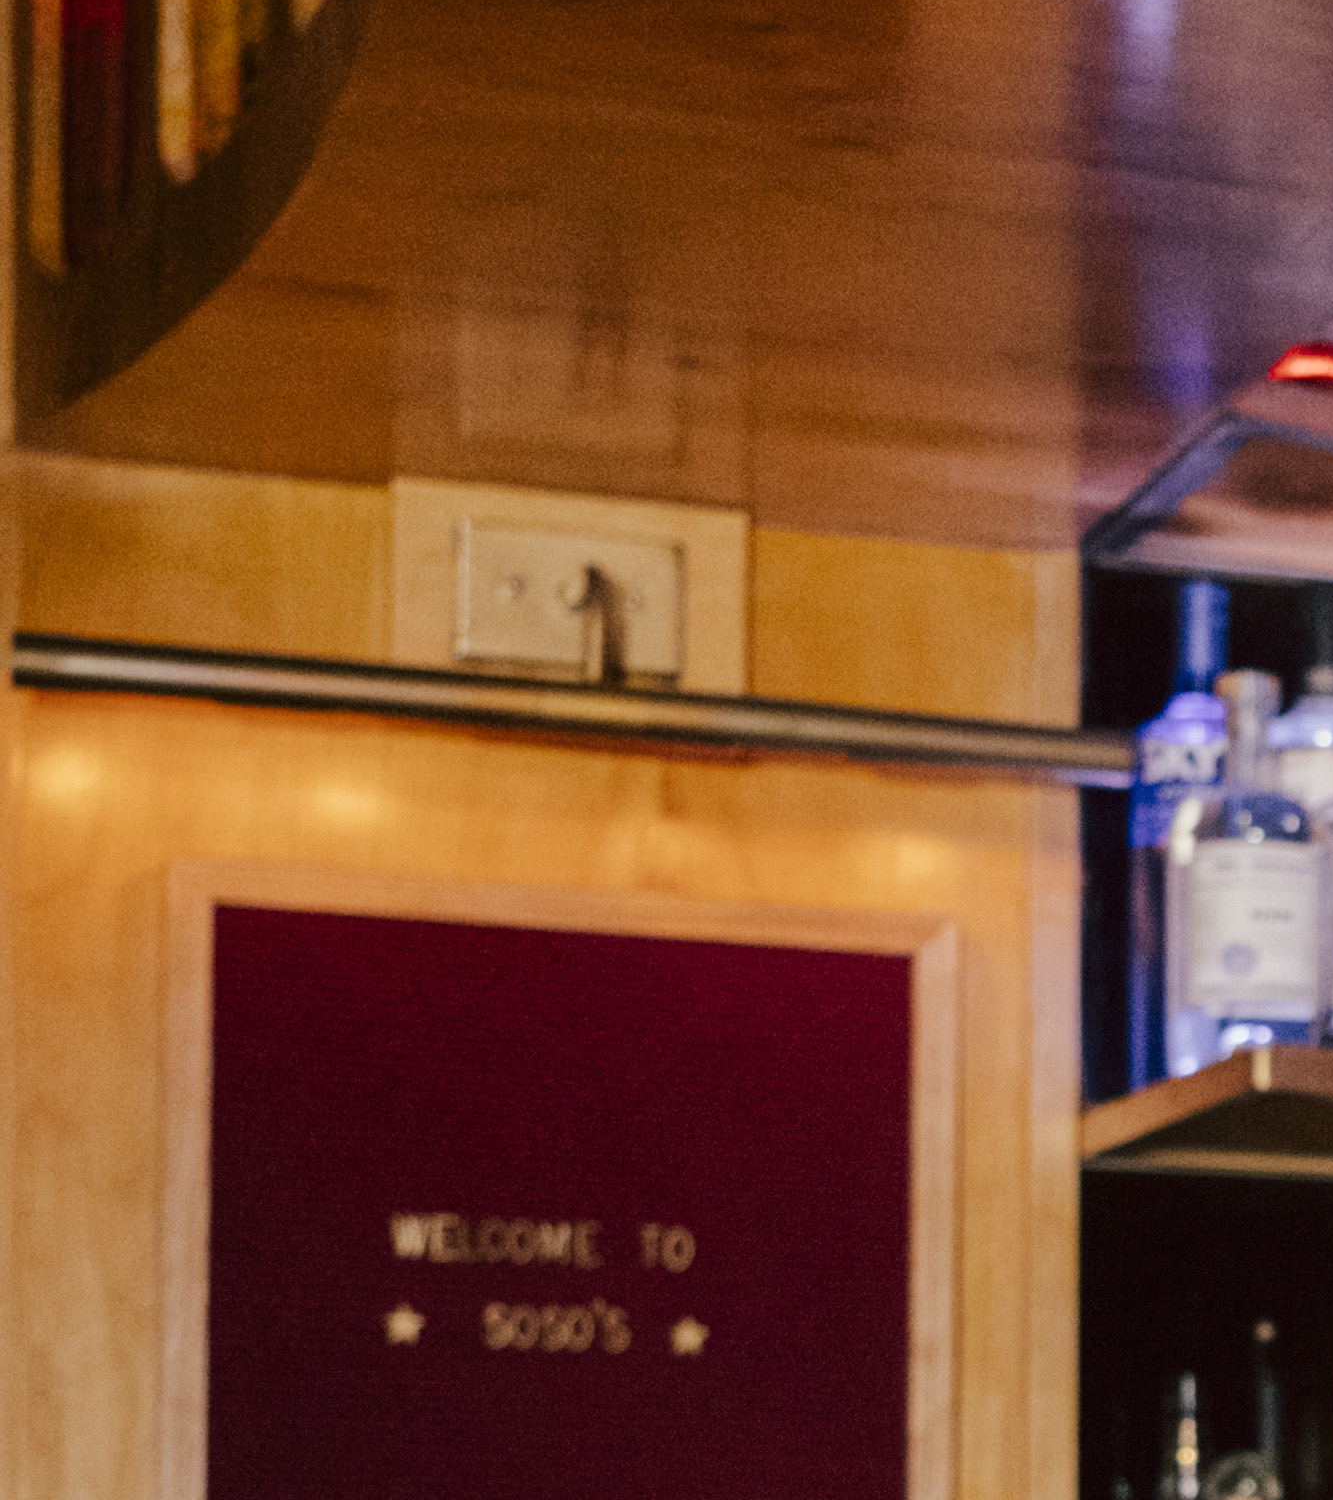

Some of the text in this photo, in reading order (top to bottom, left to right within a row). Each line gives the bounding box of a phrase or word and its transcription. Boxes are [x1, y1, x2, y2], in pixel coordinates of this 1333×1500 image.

[389, 1211, 697, 1274] WELCOME TO
[482, 1298, 633, 1355] SOSO'S
